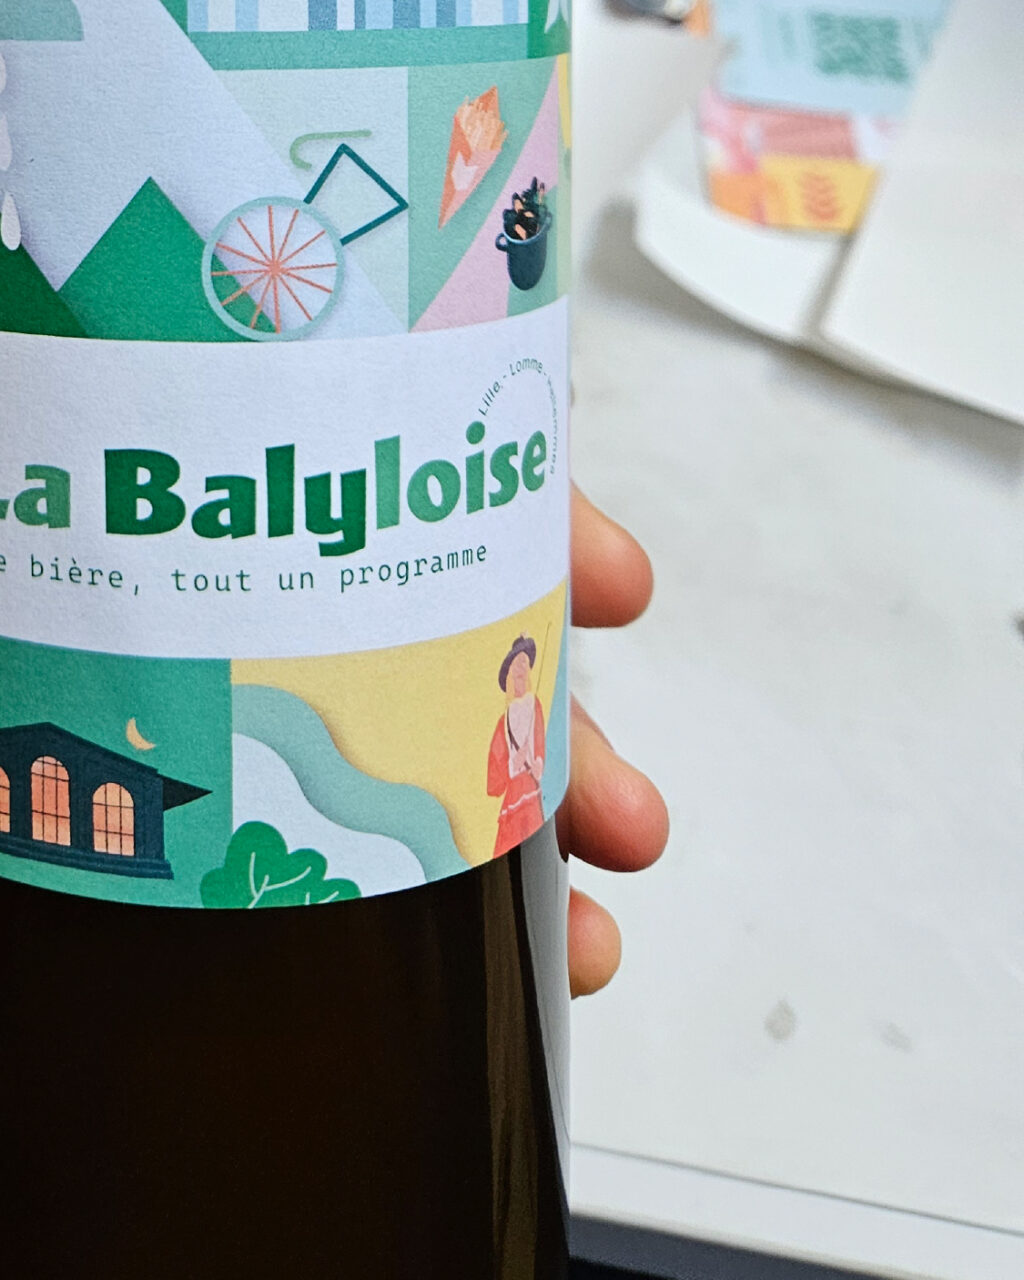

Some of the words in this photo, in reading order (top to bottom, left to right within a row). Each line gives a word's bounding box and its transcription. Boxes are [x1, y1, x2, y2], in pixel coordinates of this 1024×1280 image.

[509, 358, 543, 376] Lomme
[104, 420, 547, 558] Balyloise
[30, 554, 140, 596] bière,
[171, 568, 253, 592] tout
[279, 572, 314, 591] un
[340, 545, 488, 593] programme
